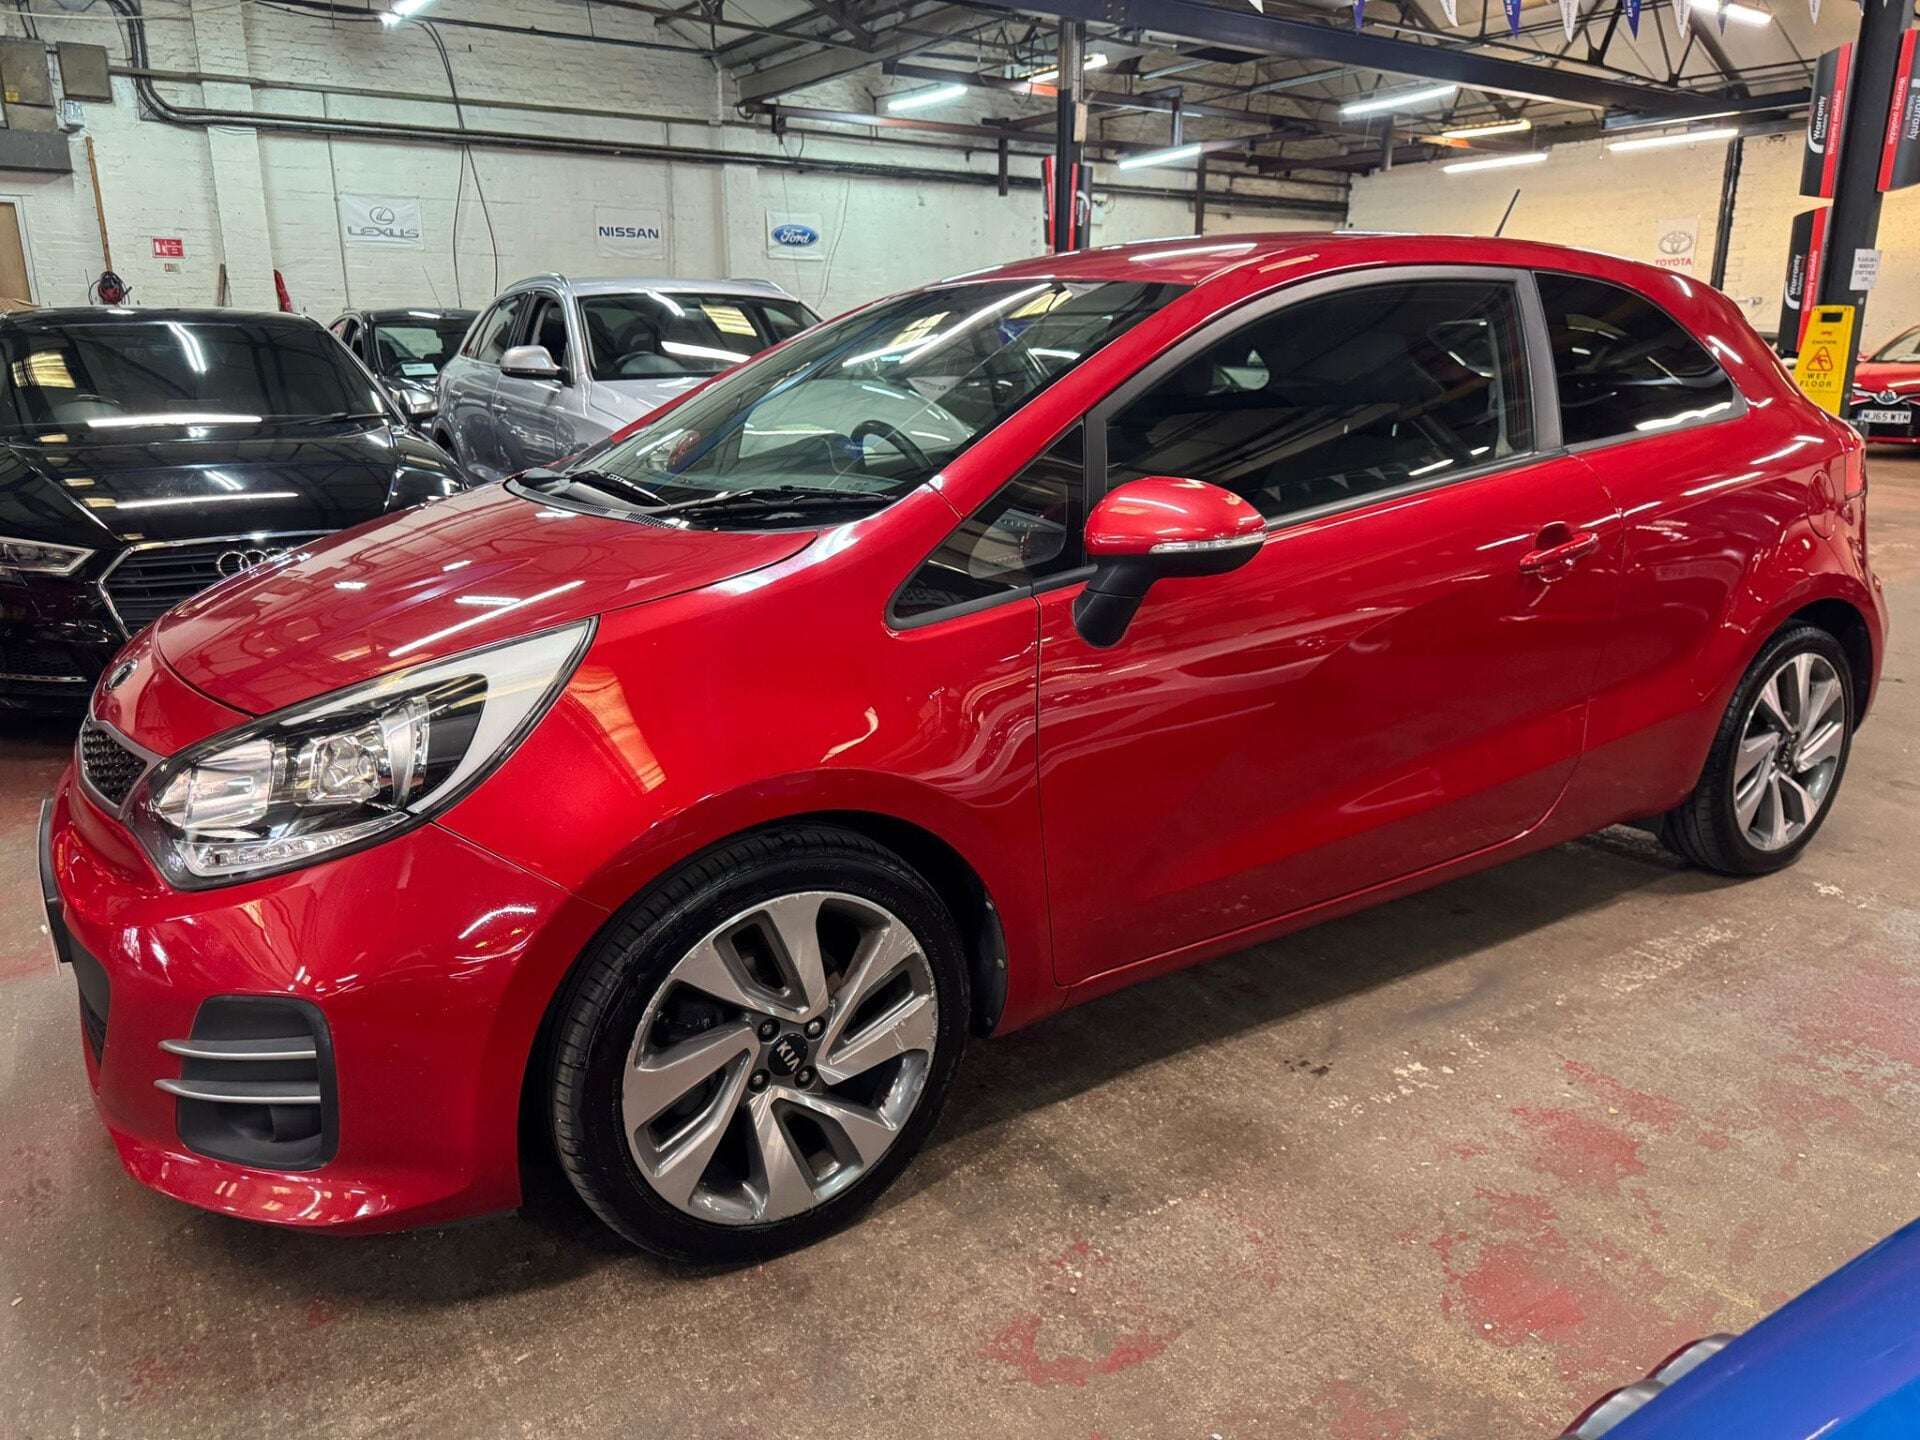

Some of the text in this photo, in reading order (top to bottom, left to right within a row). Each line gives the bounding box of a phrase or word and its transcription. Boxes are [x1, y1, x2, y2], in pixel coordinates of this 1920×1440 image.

[1813, 95, 1826, 140] Warranty
[347, 226, 419, 238] LEXUS
[599, 226, 659, 239] NISSAN
[779, 228, 810, 243] Ford
[1655, 257, 1692, 266] TOYOTA
[1789, 254, 1802, 296] Warranty
[776, 1040, 801, 1072] KIA
